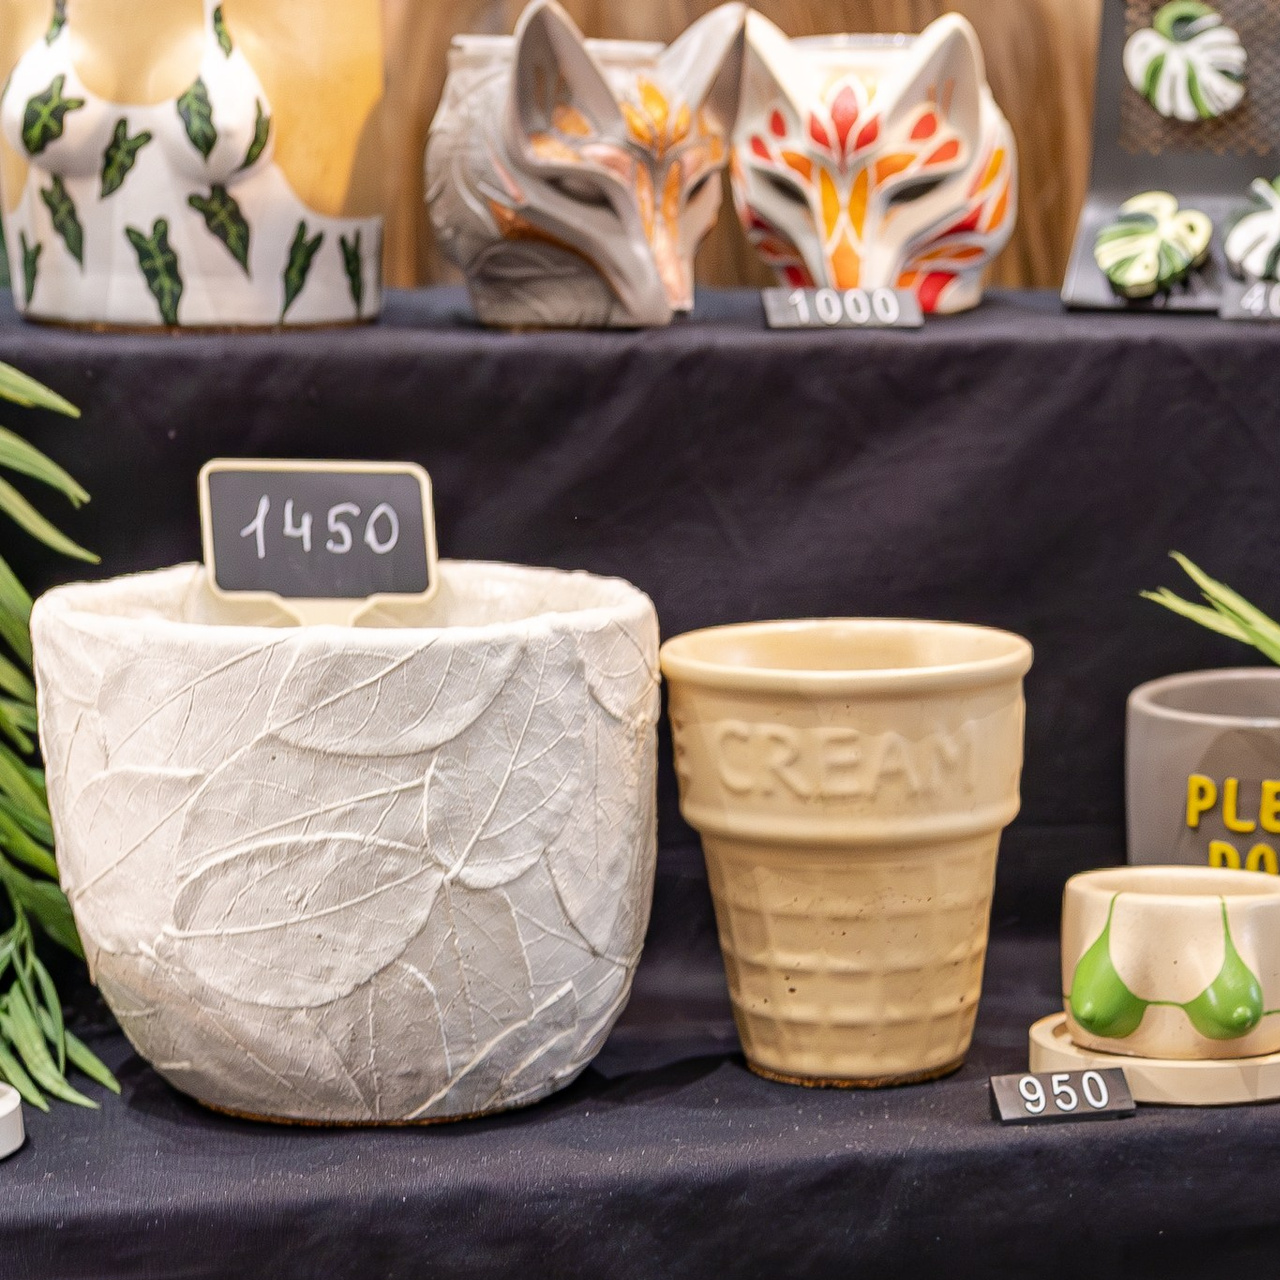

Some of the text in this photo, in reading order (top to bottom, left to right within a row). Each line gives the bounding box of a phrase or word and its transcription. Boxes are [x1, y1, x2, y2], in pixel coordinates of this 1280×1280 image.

[788, 287, 900, 326] 1000
[239, 494, 401, 560] 1450
[716, 717, 978, 802] CREAM
[1018, 1070, 1109, 1114] 950
